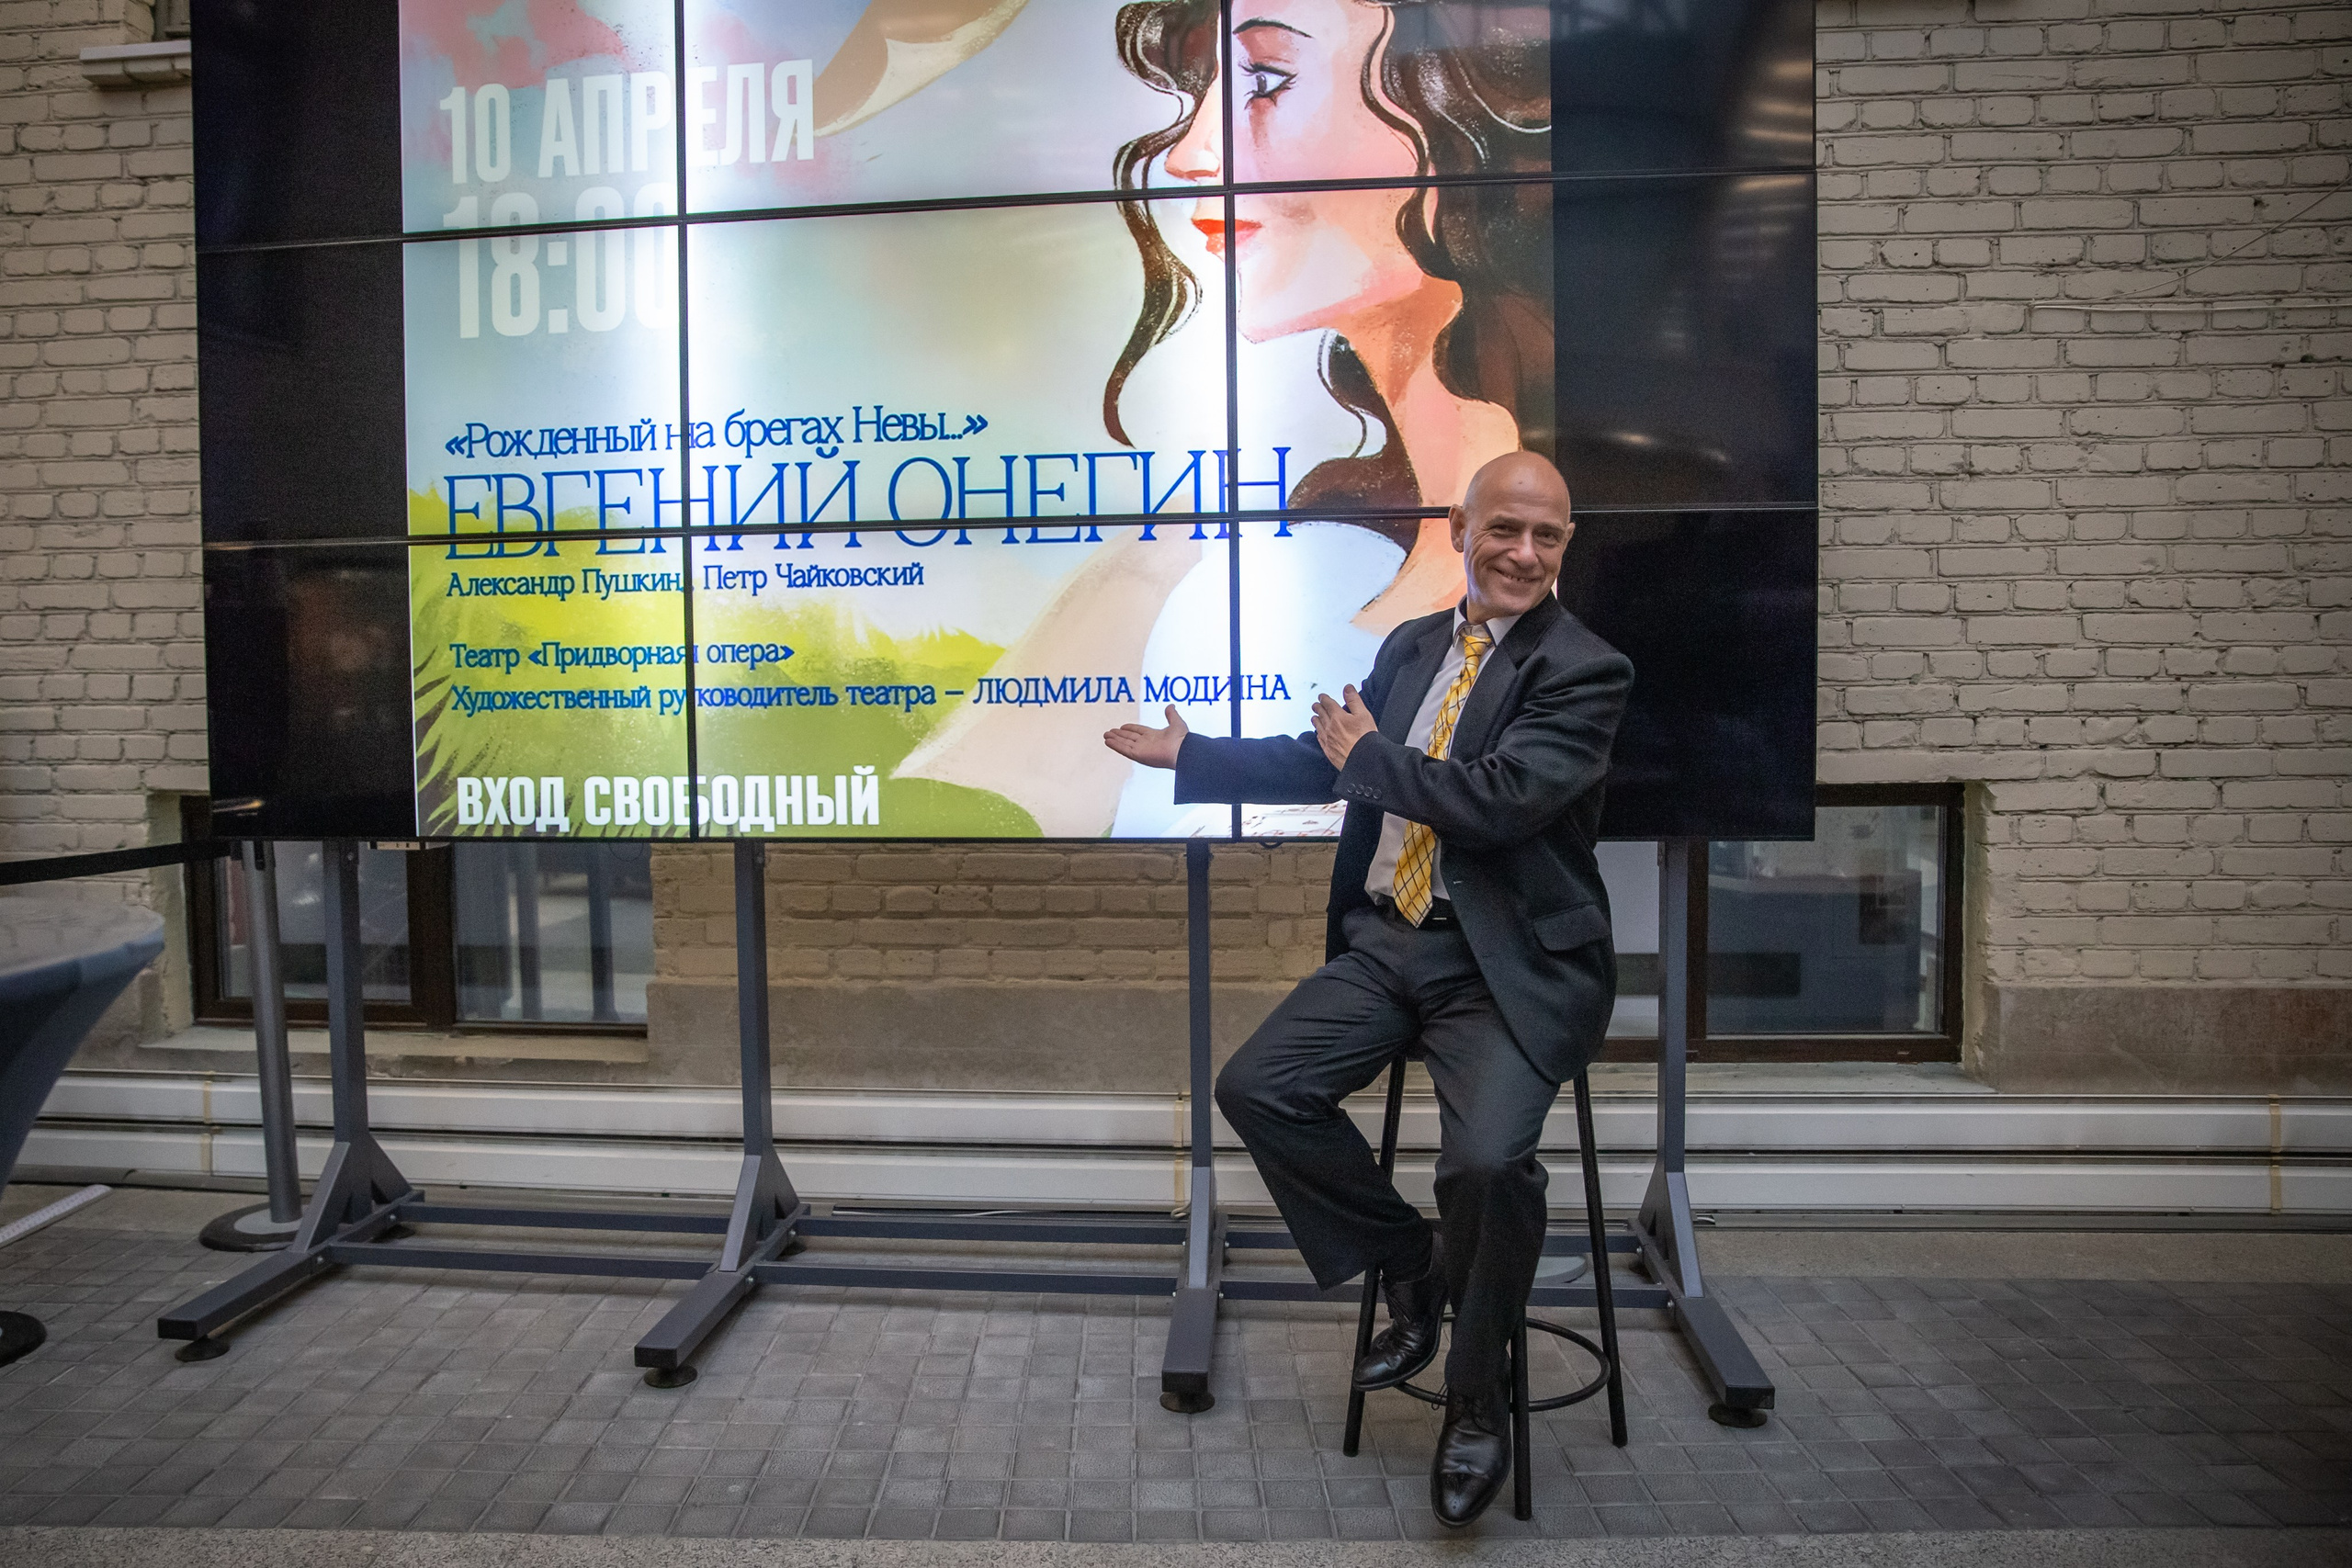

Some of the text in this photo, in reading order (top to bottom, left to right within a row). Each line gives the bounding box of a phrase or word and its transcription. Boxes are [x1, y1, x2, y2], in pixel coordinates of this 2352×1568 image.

[439, 59, 814, 184] 10 АПРЕЛЯ
[443, 182, 681, 339] 18:00
[445, 418, 657, 459] «Рожденный
[665, 421, 716, 450] на
[725, 409, 843, 457] брегах
[444, 445, 1293, 560] ЕВГЕНИЙ ОНЕГИН
[447, 571, 575, 601] Александр
[703, 565, 768, 596] Петр
[775, 561, 924, 590] Чайковский
[449, 642, 795, 674] Театр «Придворная опера»
[450, 685, 650, 716] Художественный
[659, 684, 838, 715] руководитель
[846, 682, 936, 713] театра
[973, 676, 1135, 706] ЛЮДМИЛА
[1144, 673, 1291, 706] МОДИНА
[457, 765, 879, 833] ВХОД СВОБОДНЫЙ
